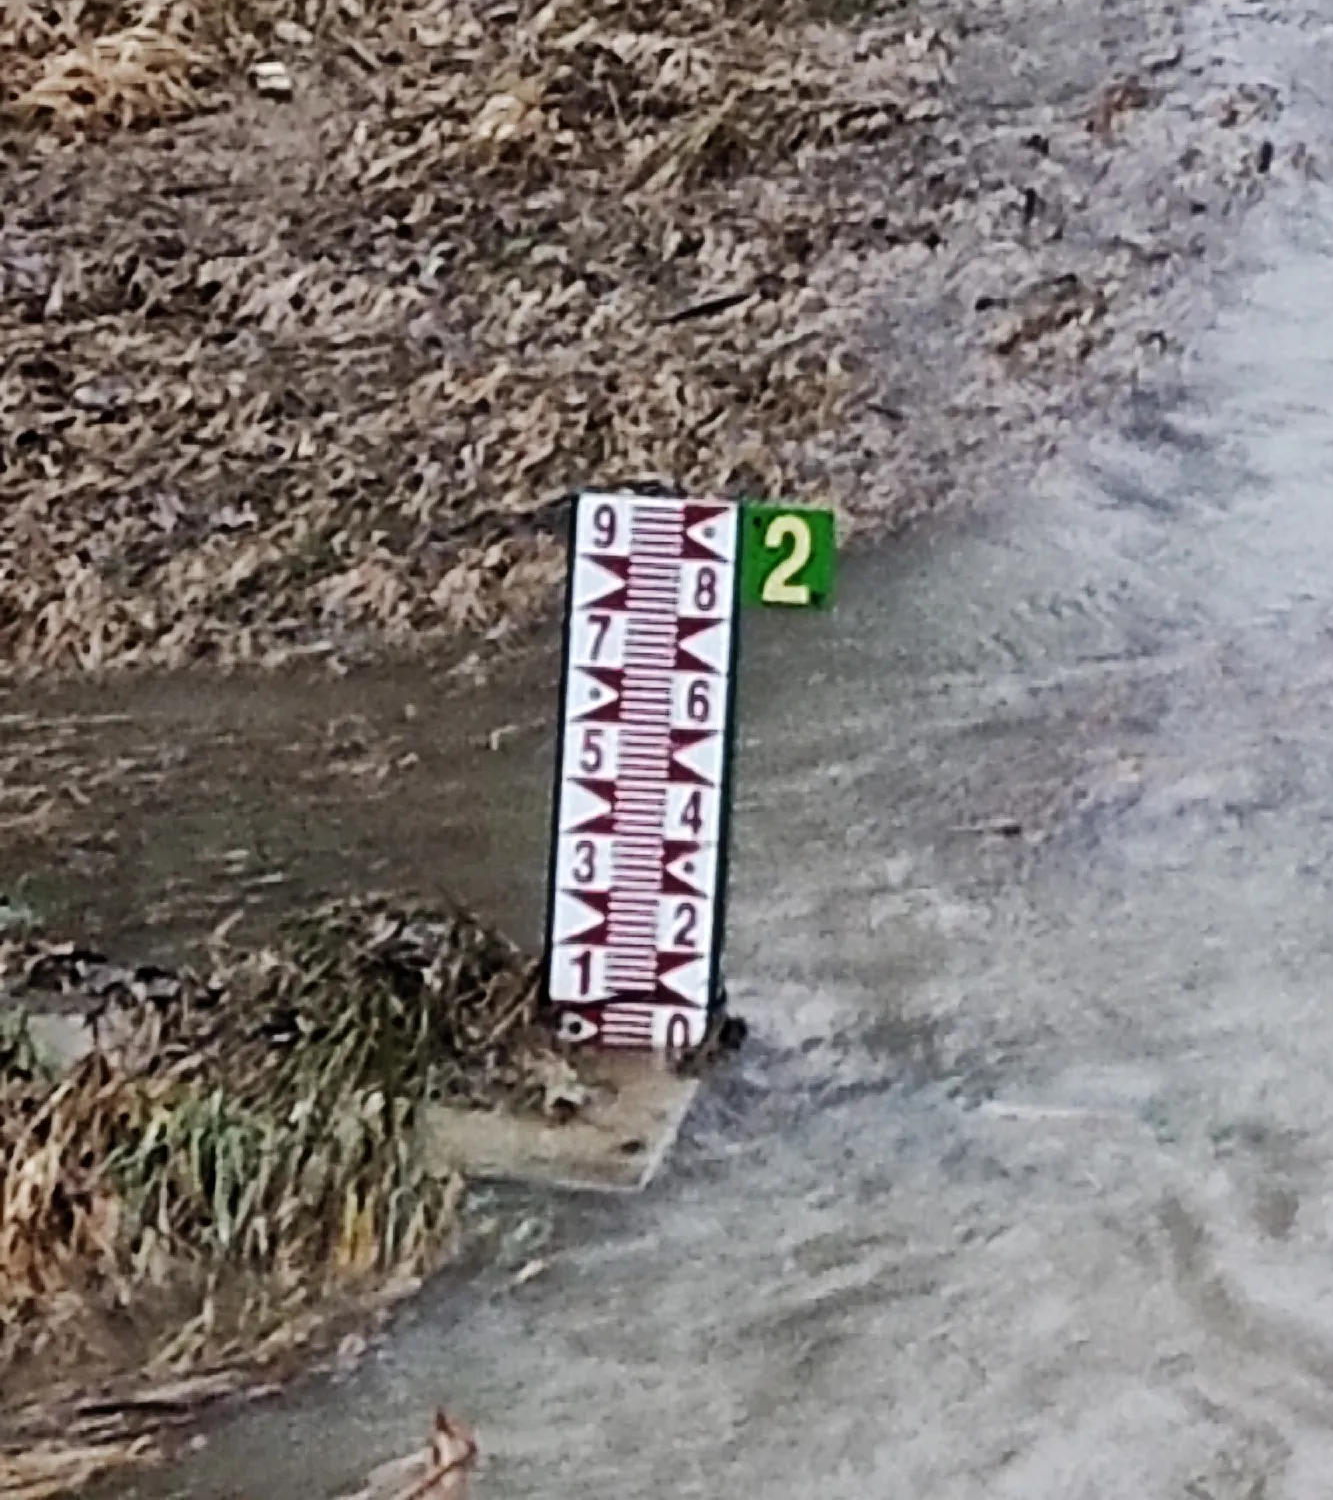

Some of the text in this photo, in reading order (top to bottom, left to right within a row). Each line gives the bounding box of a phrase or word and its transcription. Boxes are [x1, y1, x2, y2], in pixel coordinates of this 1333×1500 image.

[592, 503, 617, 549] 9
[761, 513, 812, 605] 2
[693, 566, 717, 611] 8
[587, 614, 612, 661] 7
[686, 679, 710, 722] 6
[580, 729, 603, 773] 5
[680, 790, 703, 835] 4
[572, 839, 596, 883] 3
[673, 902, 697, 948] 2
[569, 950, 592, 995] 1
[666, 1013, 690, 1054] 0
